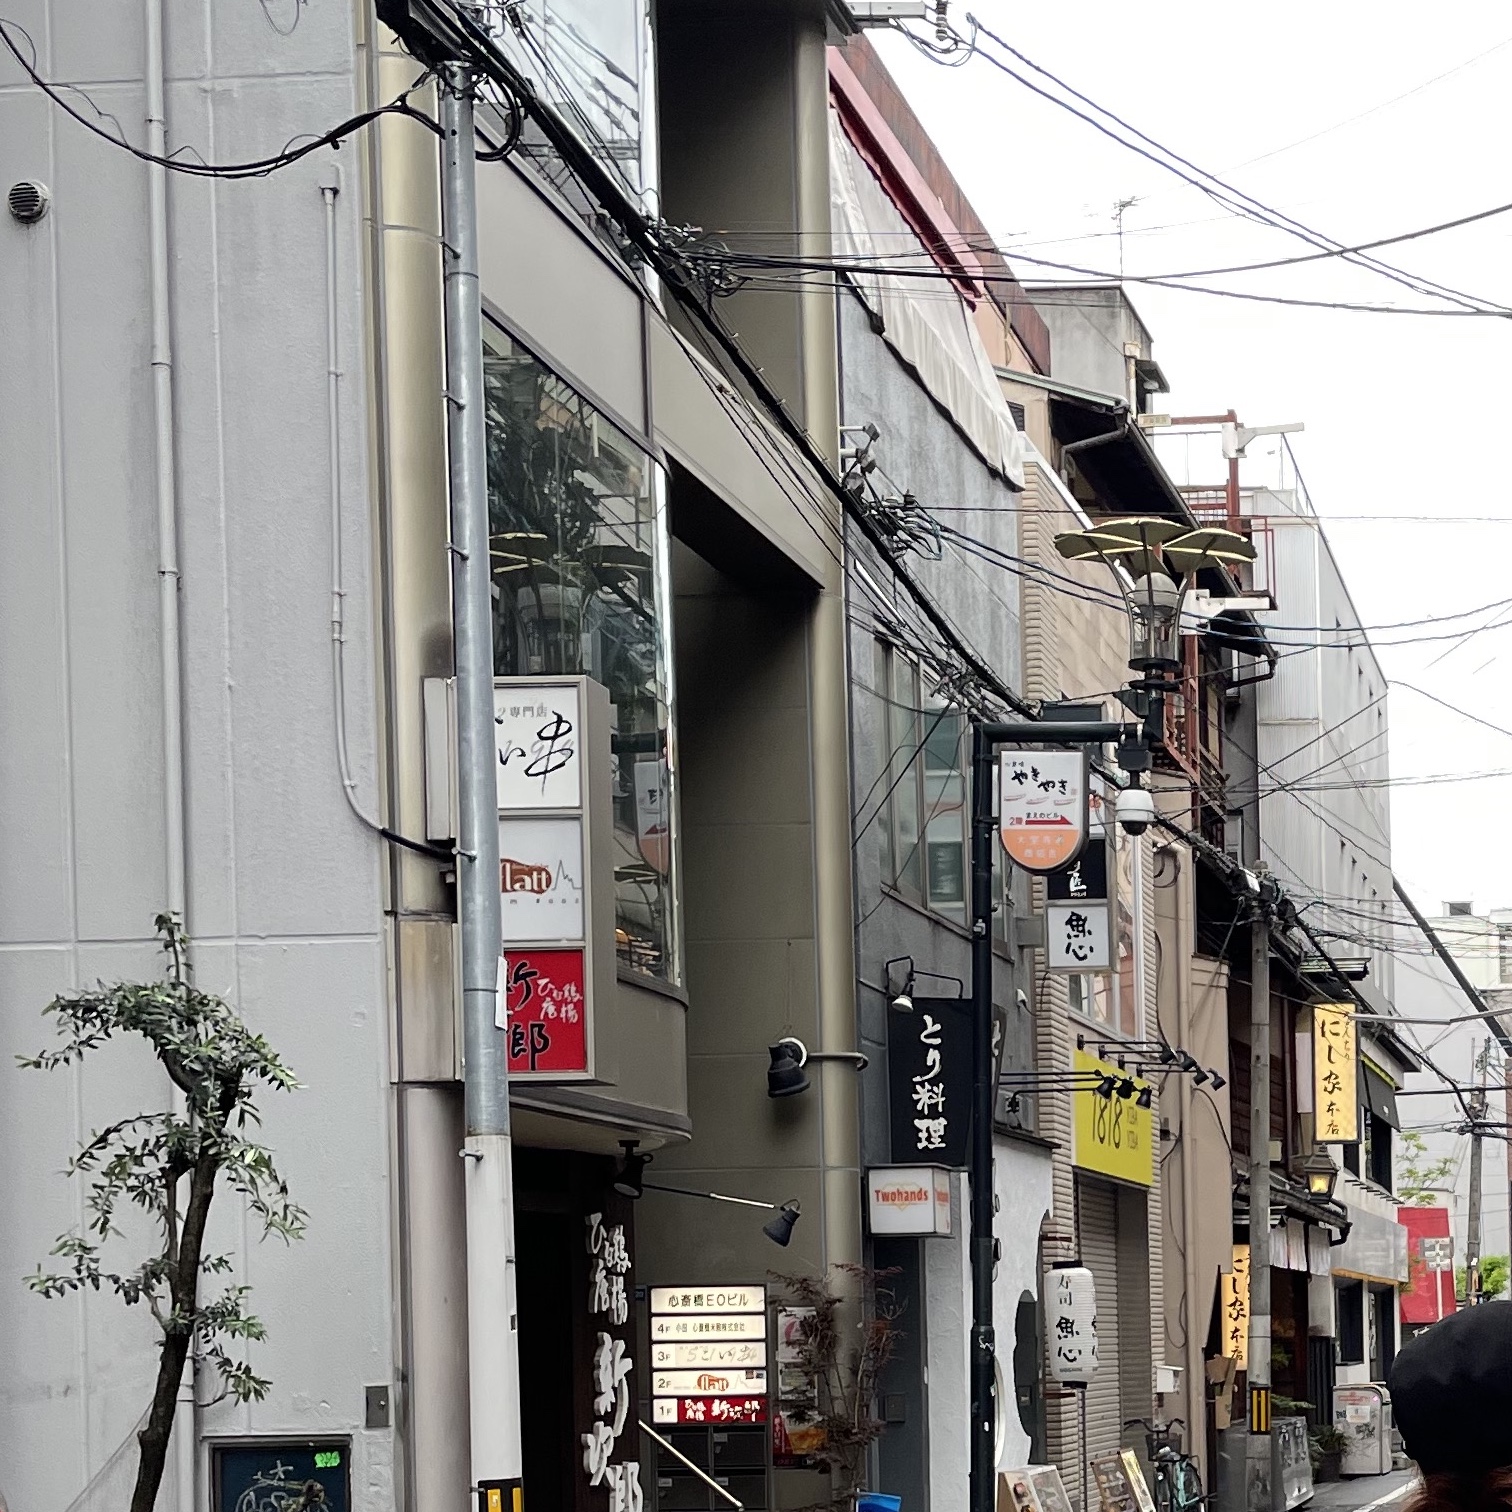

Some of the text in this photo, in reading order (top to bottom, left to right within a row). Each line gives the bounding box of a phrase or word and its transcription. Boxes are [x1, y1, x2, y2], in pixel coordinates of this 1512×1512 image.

[1011, 766, 1068, 796] やきやき
[912, 1014, 947, 1149] とり料理
[874, 1189, 928, 1203] Twohands
[658, 1323, 670, 1333] 4F
[658, 1352, 670, 1361] 3F
[658, 1378, 672, 1389] 2F
[659, 1406, 672, 1416] 1F
